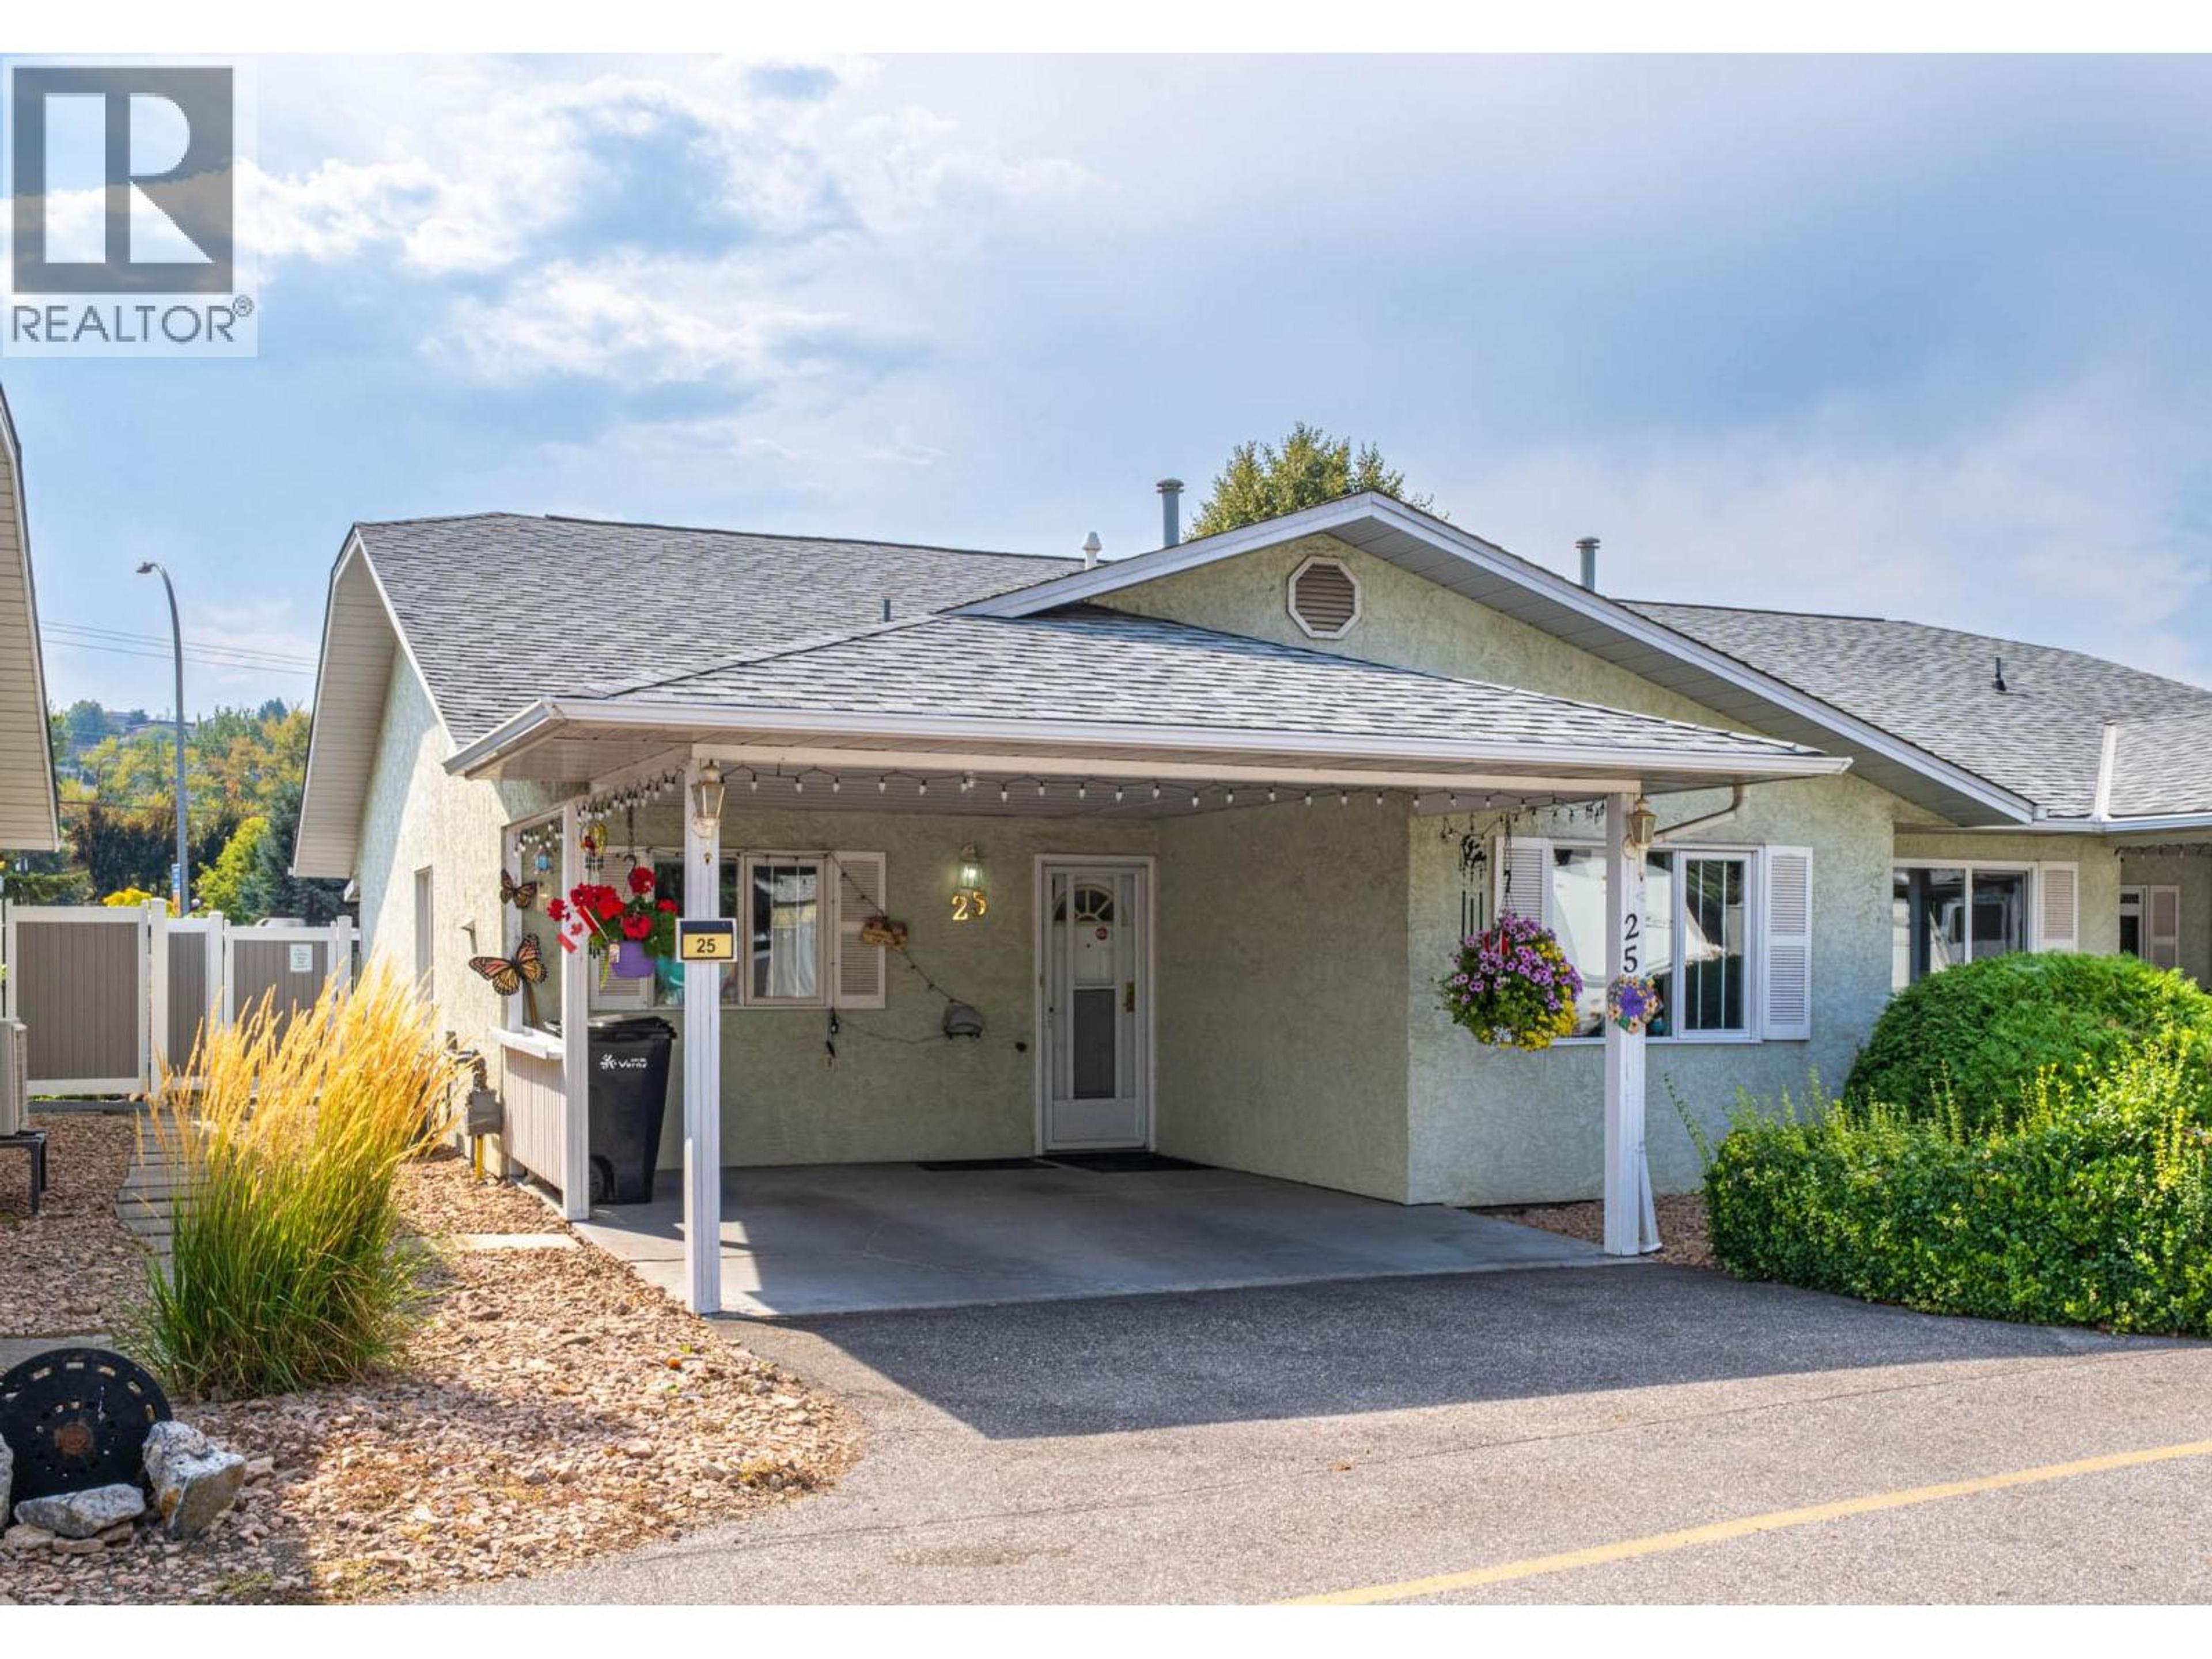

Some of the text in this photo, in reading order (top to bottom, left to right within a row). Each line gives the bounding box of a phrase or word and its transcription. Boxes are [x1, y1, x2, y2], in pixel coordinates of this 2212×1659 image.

[952, 890, 987, 921] 25
[696, 938, 715, 953] 25
[1623, 913, 1639, 972] 25
